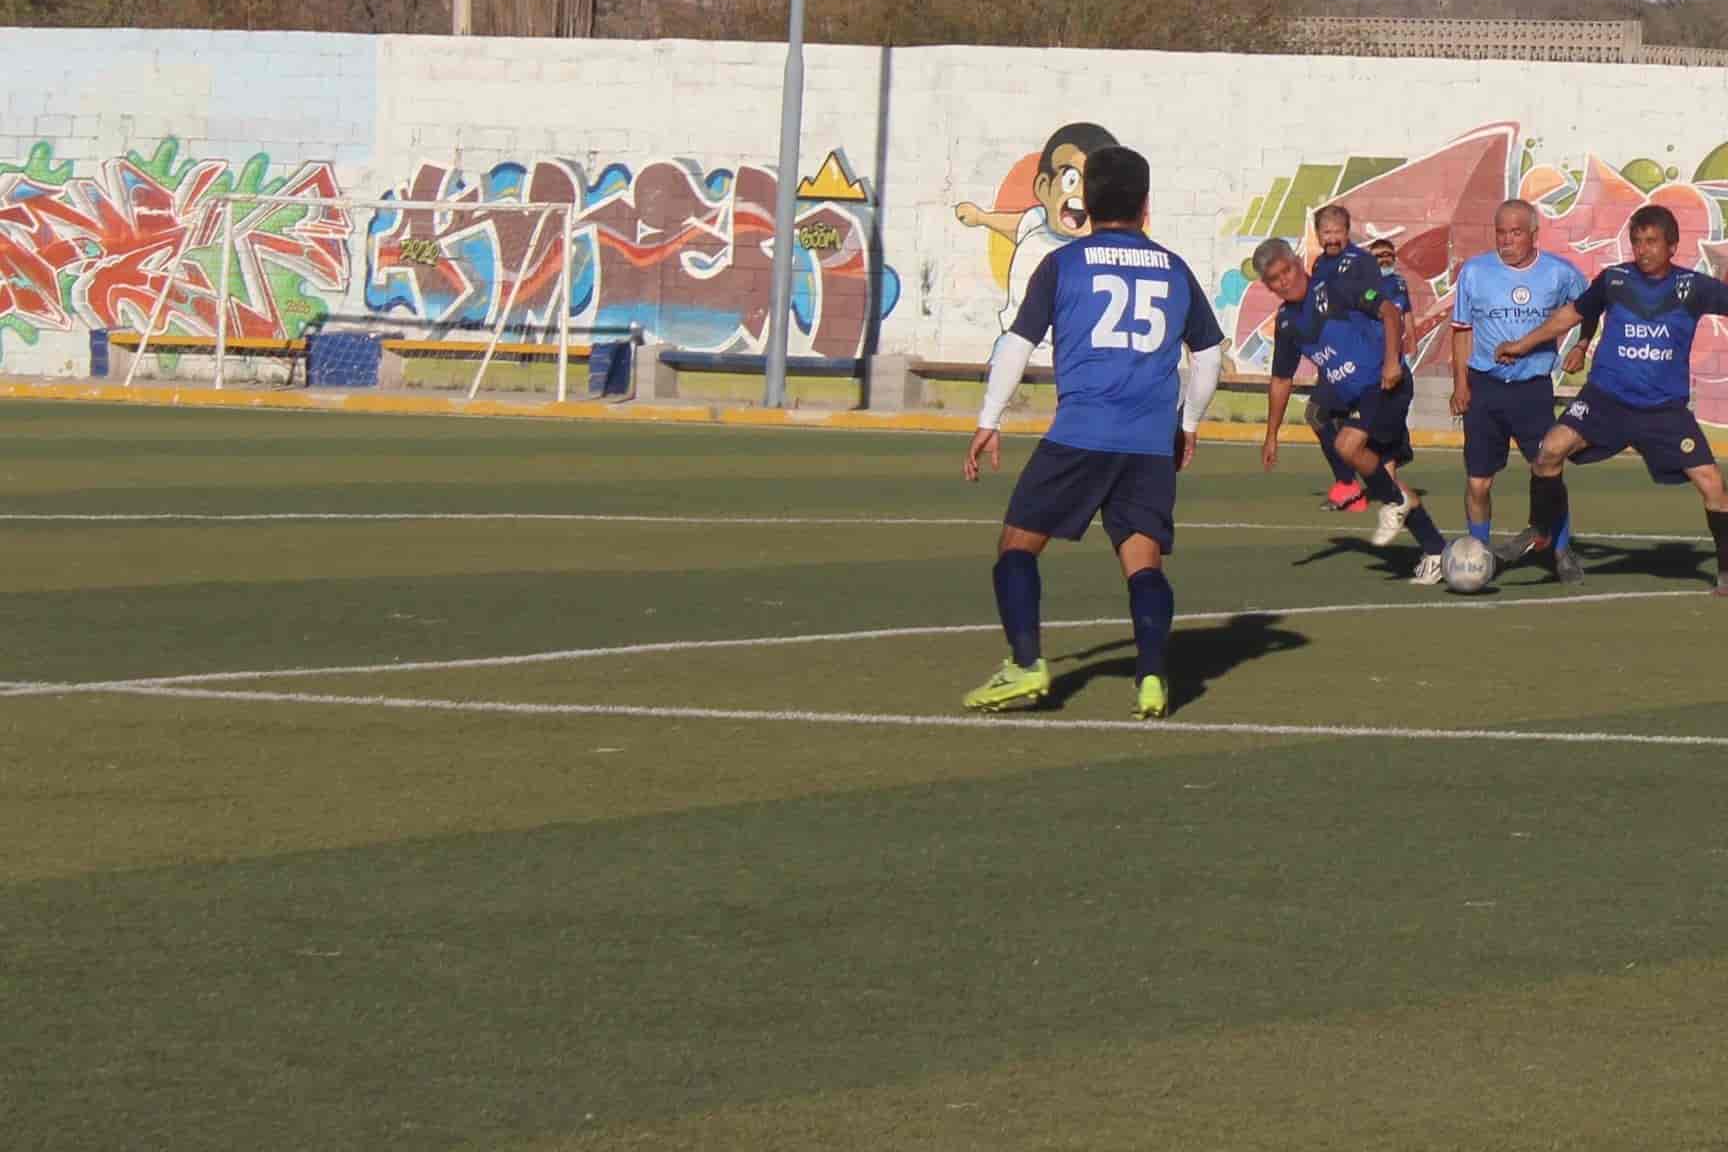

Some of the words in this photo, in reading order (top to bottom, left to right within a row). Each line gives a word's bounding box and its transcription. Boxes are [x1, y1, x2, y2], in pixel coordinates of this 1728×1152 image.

[1084, 246, 1170, 270] INDEPENDIENTE
[1091, 274, 1169, 353] 25
[1624, 323, 1671, 339] BBVA
